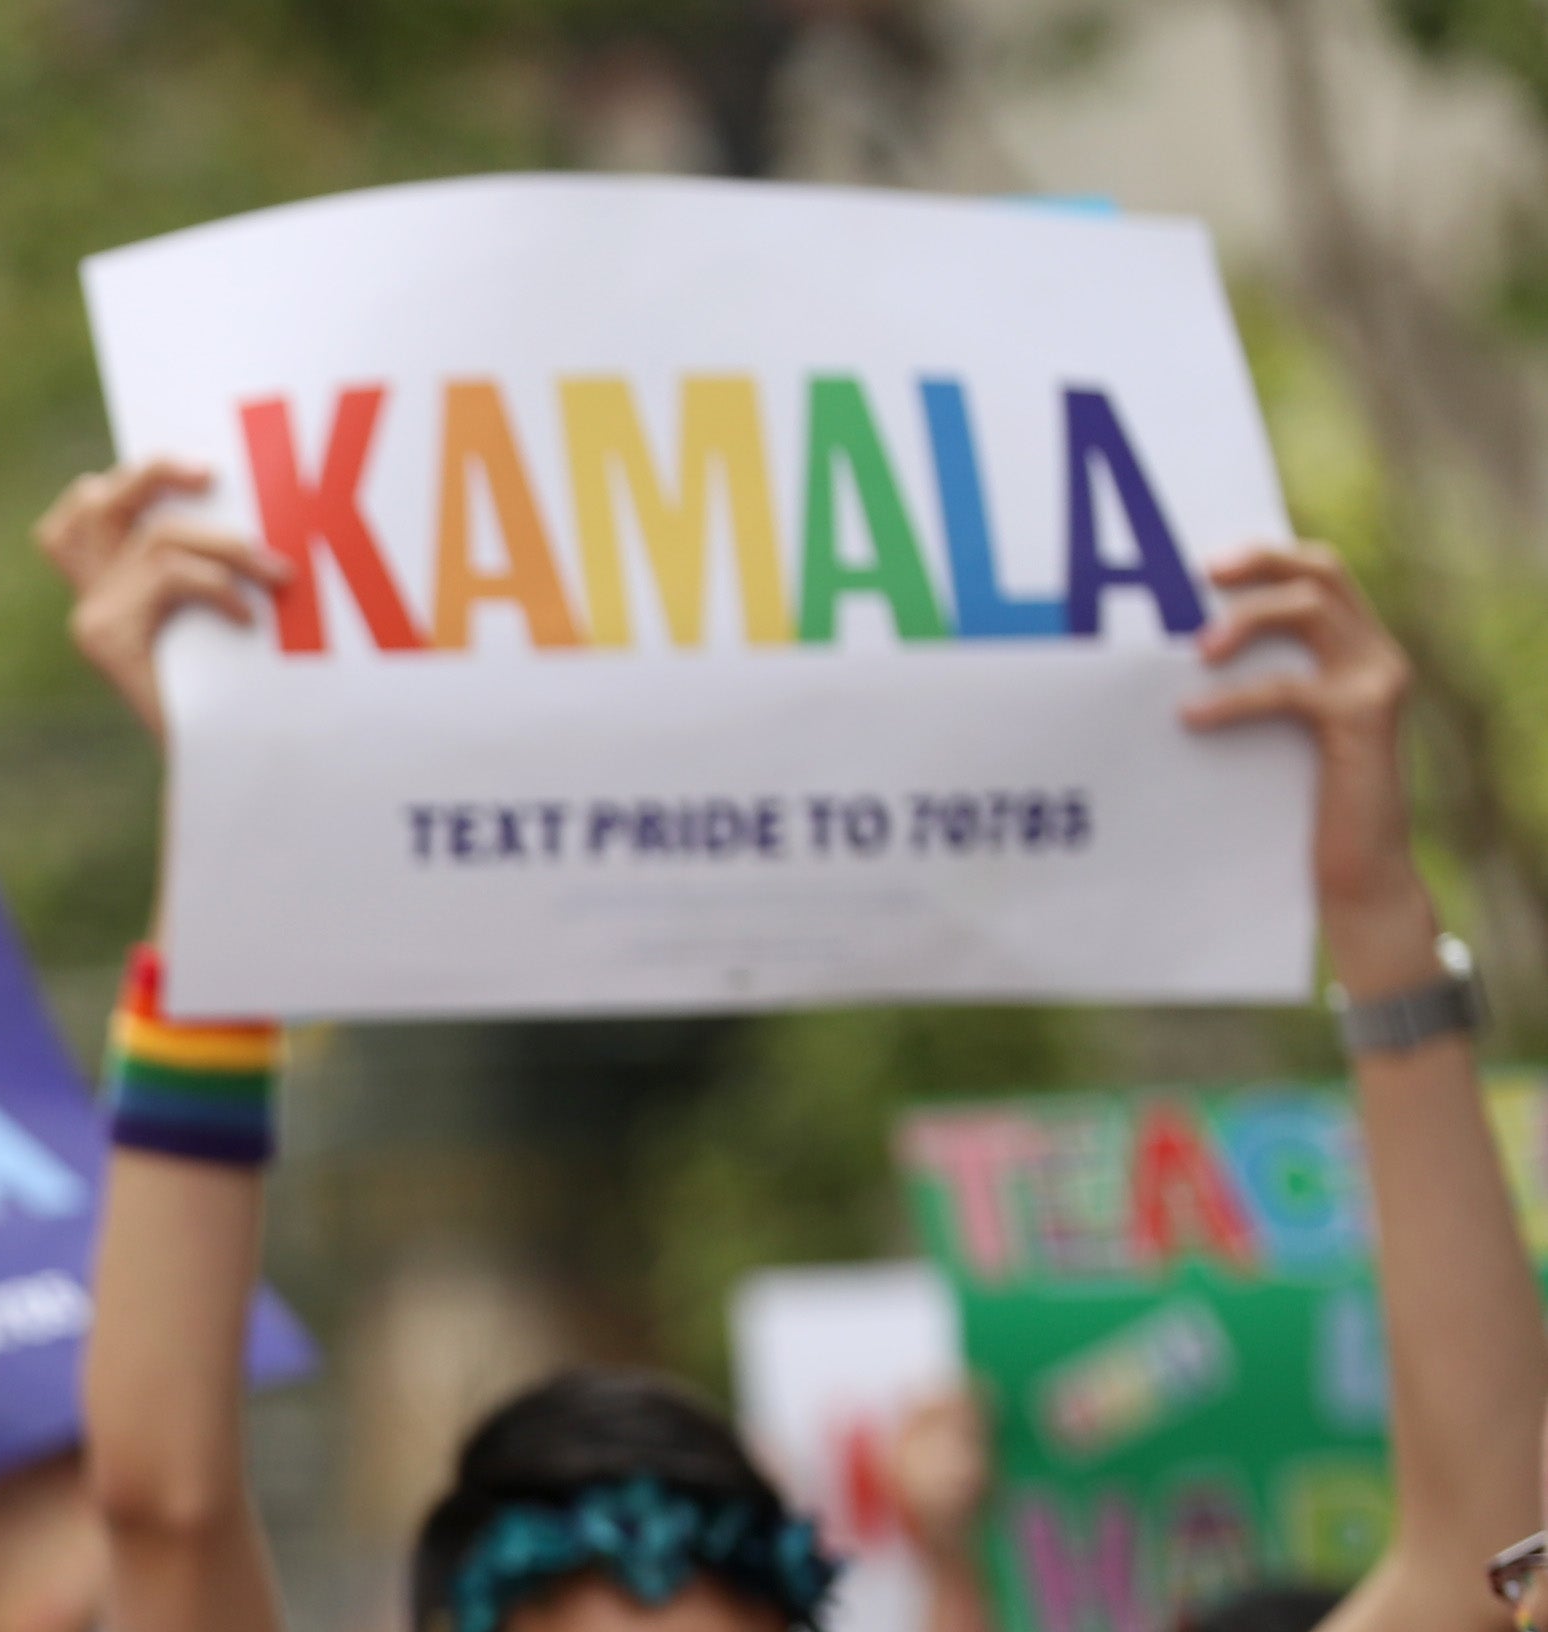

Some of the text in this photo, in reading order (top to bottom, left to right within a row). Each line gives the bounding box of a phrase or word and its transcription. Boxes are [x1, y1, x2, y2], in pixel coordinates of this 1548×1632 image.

[237, 372, 1210, 655] KAMALA
[408, 804, 562, 862] TEXT
[588, 801, 785, 860] PRIDE
[806, 796, 892, 857] TO
